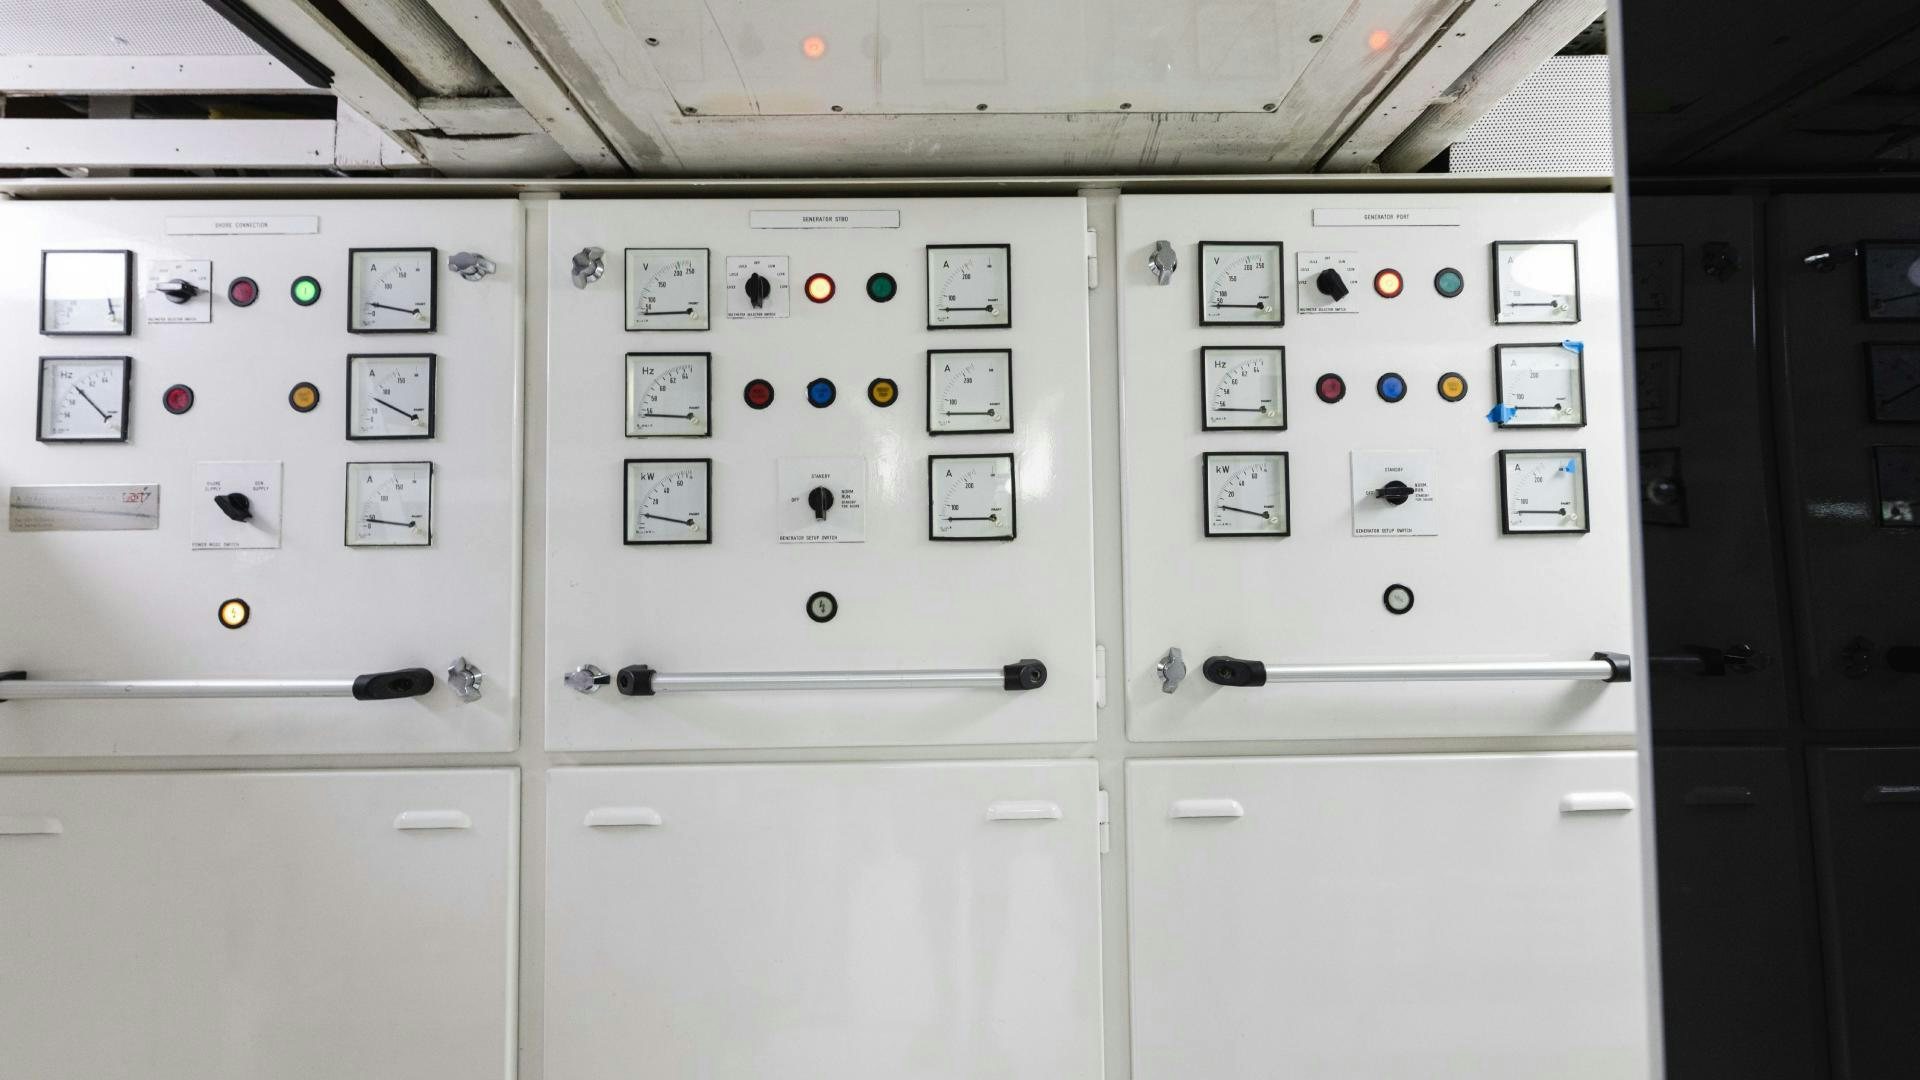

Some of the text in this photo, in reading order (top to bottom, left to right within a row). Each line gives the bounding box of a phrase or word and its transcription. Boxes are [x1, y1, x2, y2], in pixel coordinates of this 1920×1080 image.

[370, 264, 376, 272] A
[643, 263, 648, 271] V
[642, 367, 654, 375] Hz
[1216, 465, 1230, 473] kW
